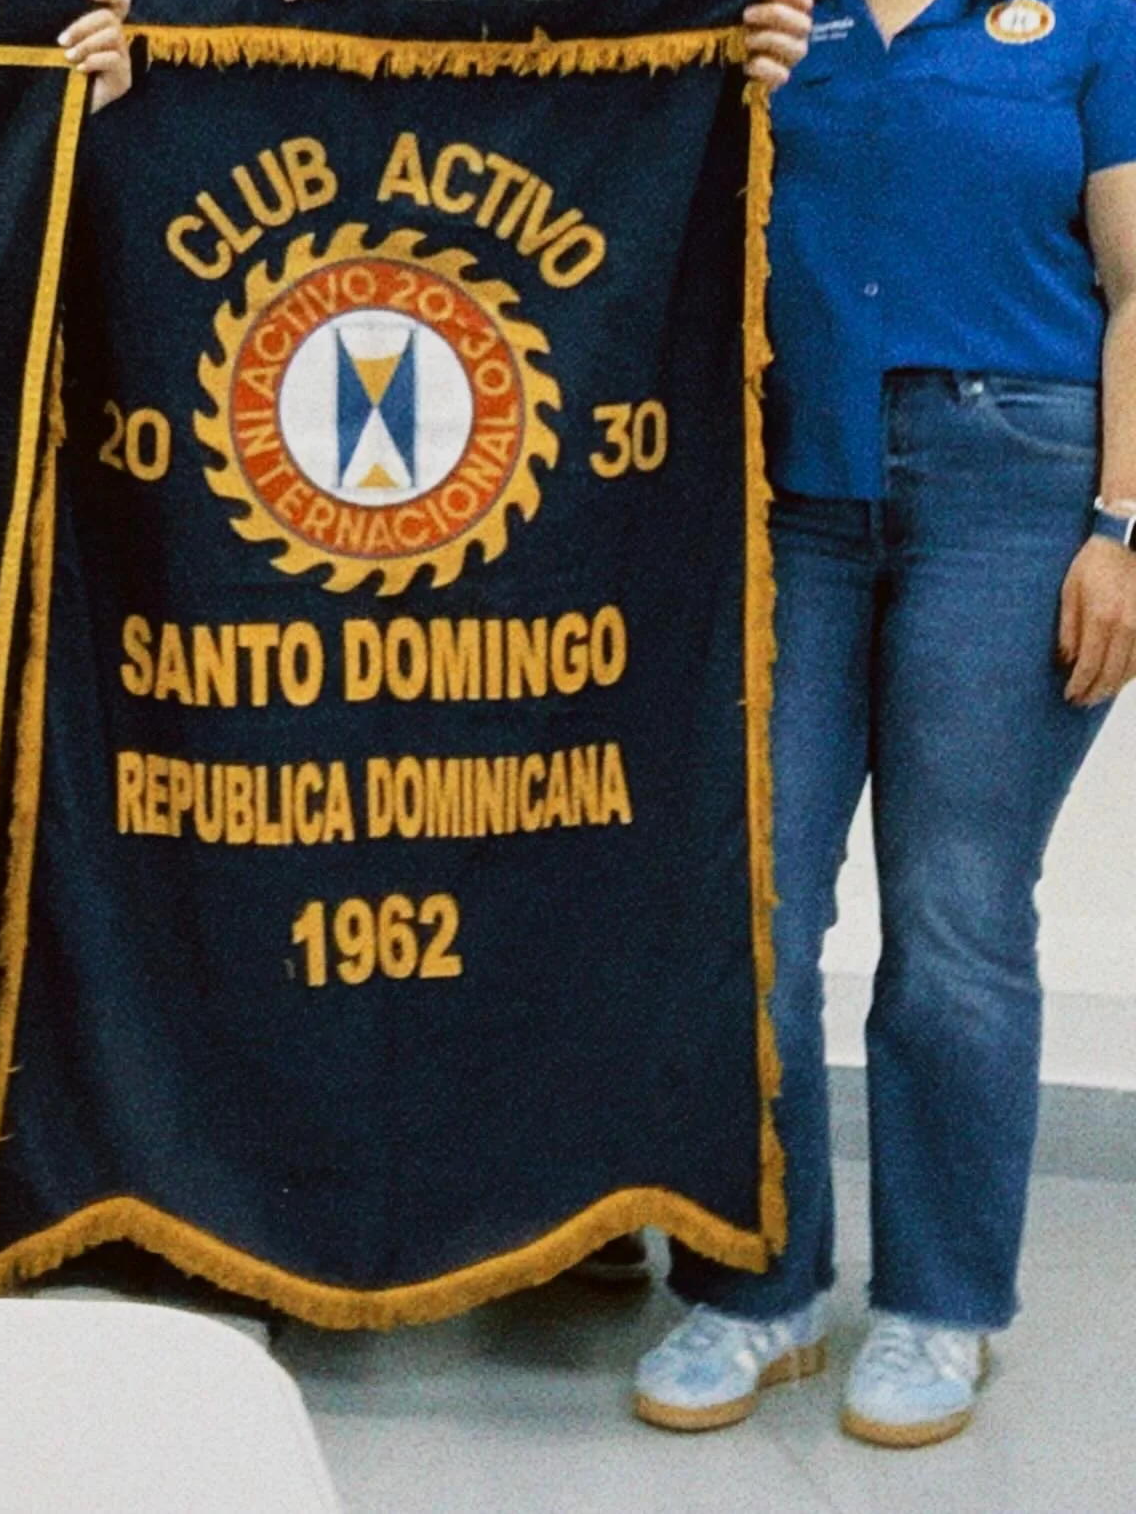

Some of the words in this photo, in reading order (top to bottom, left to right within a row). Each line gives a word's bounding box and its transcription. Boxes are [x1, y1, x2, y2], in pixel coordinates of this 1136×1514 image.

[166, 136, 338, 281] CLUB
[377, 131, 607, 289] ACTIVO
[247, 265, 377, 401] ACTIVO
[388, 271, 513, 397] 20-30
[98, 398, 172, 481] 20
[237, 409, 520, 553] INTERNACIONAL
[590, 400, 668, 479] 30
[120, 613, 324, 708] SANTO
[343, 605, 628, 703] DOMINGO
[116, 750, 356, 846] REPUBLICA
[366, 742, 633, 840] DOMINICANA
[291, 893, 463, 987] 1962
